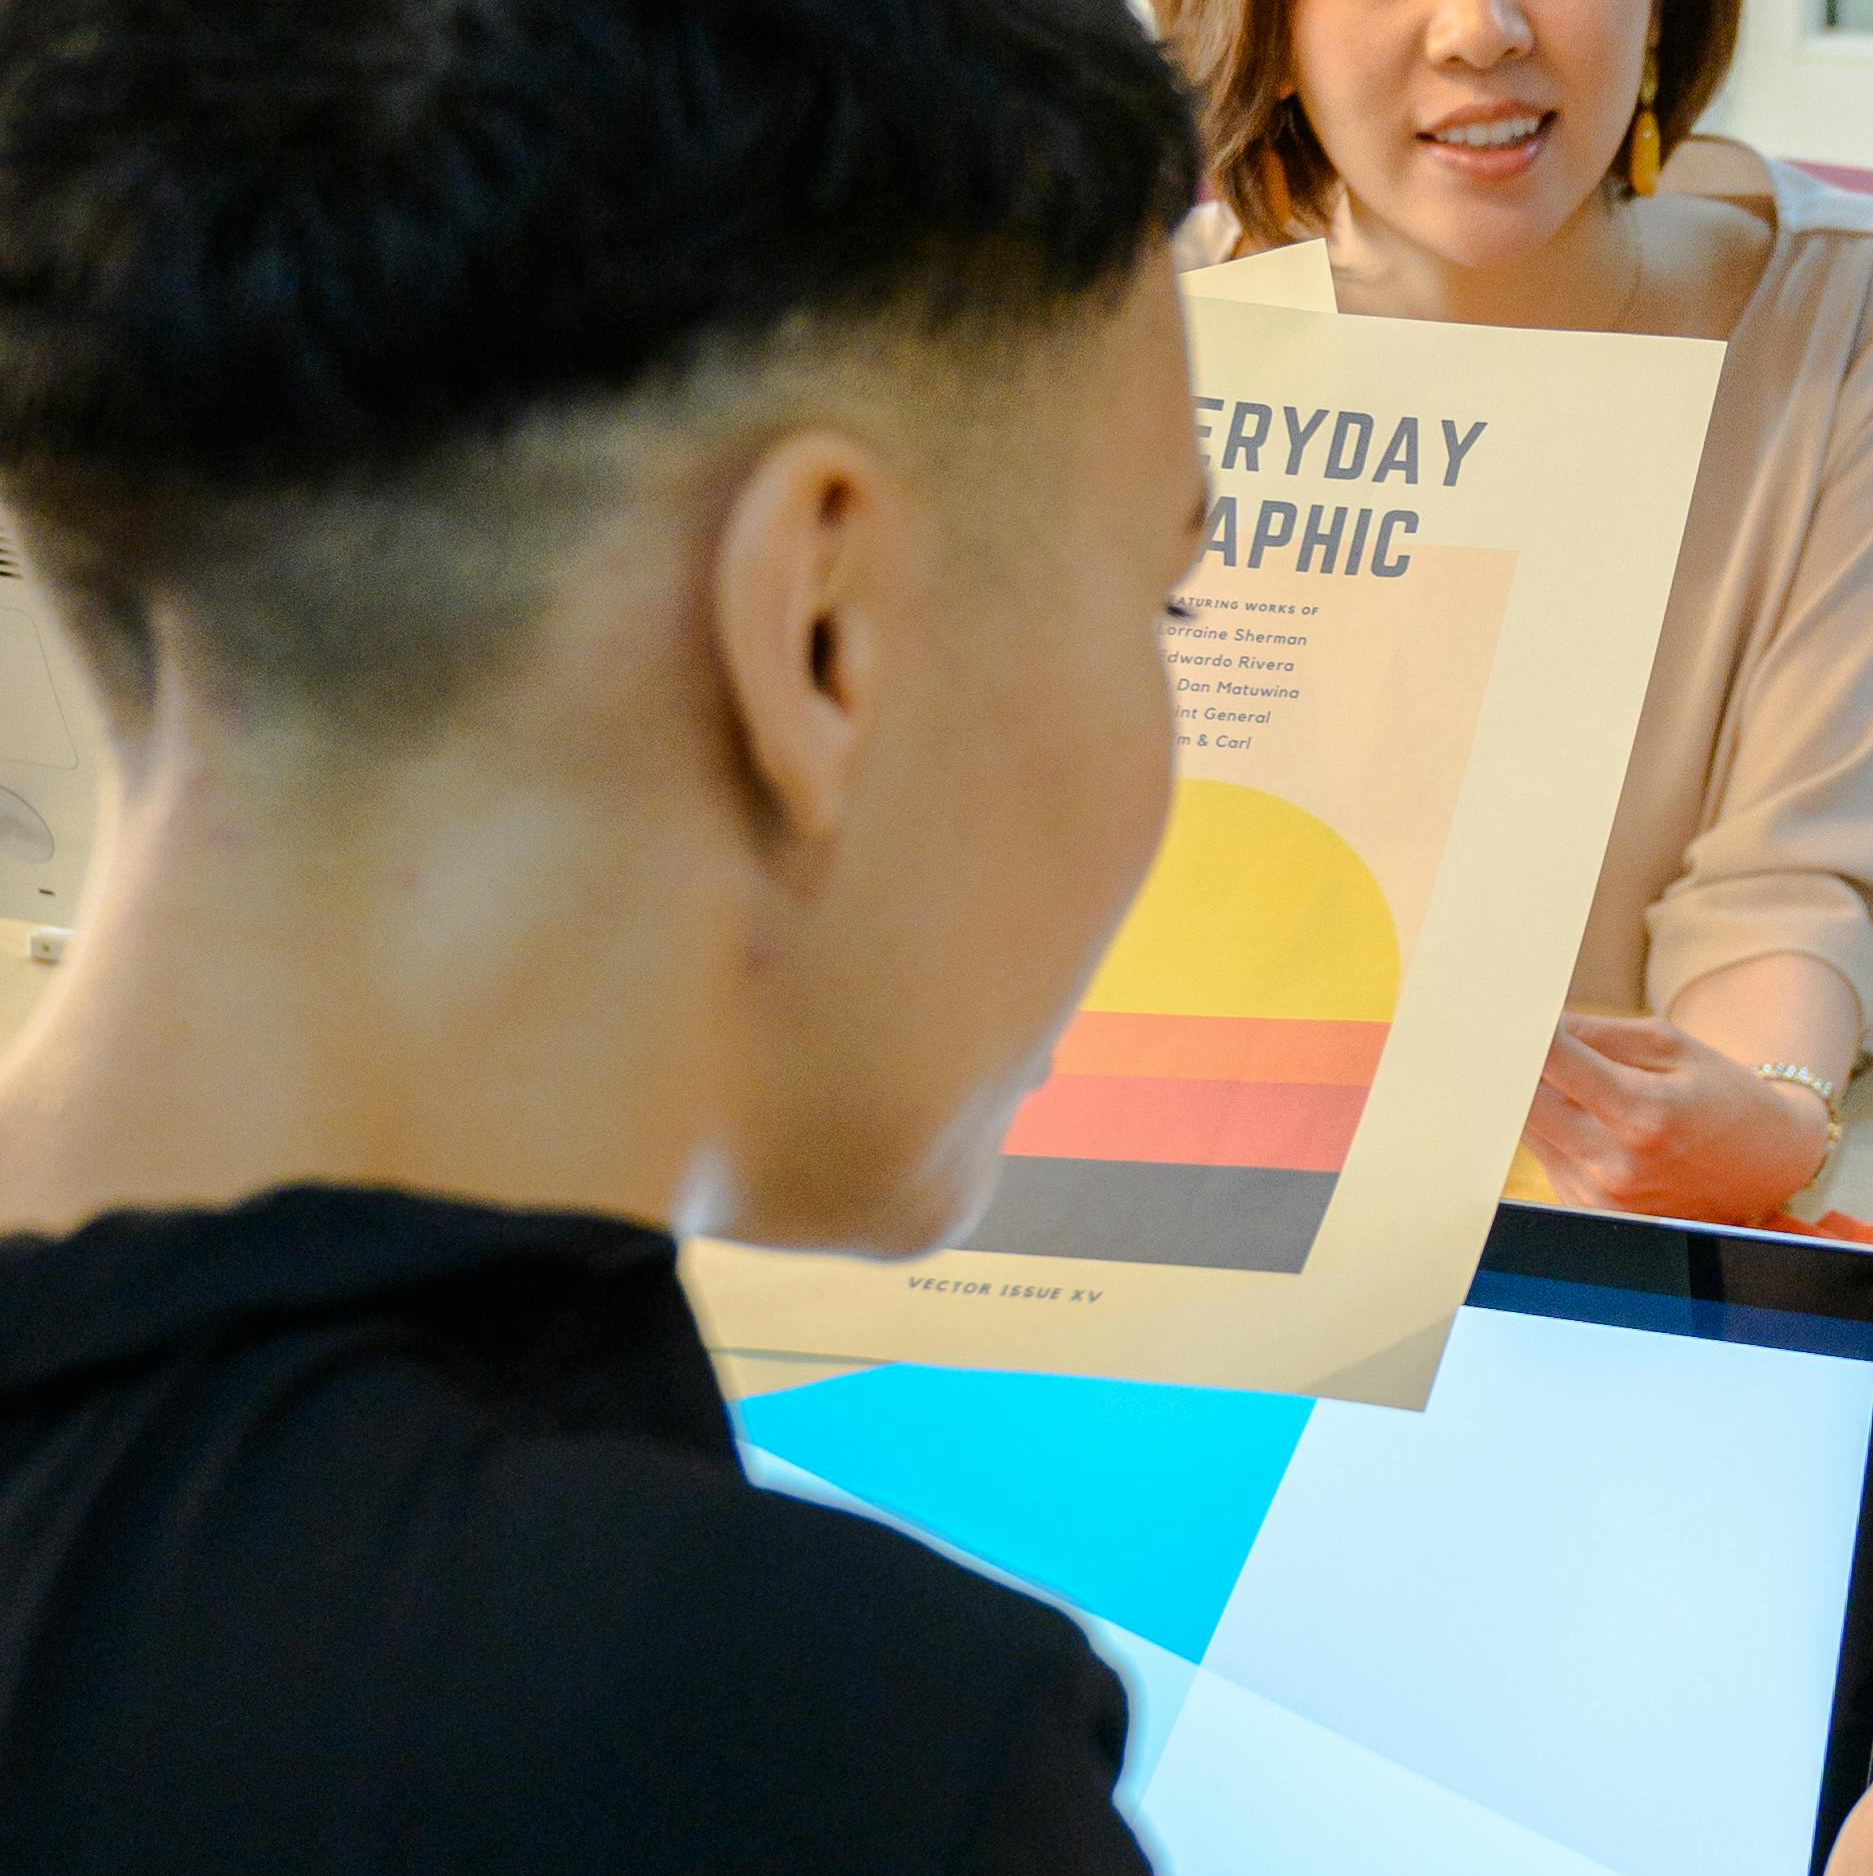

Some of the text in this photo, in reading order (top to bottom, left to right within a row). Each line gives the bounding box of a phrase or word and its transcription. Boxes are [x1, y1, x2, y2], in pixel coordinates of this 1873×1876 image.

[1245, 601, 1297, 615] WORKS
[1301, 605, 1320, 616] OF
[1234, 627, 1308, 646] Sherman
[1238, 655, 1295, 672] Rivera
[1176, 678, 1300, 700] Dan Matuwina
[1204, 706, 1271, 724] General
[1196, 733, 1209, 747] &
[1215, 733, 1252, 750] Carl
[908, 1275, 1104, 1303] VECTOR ISSUE XV
